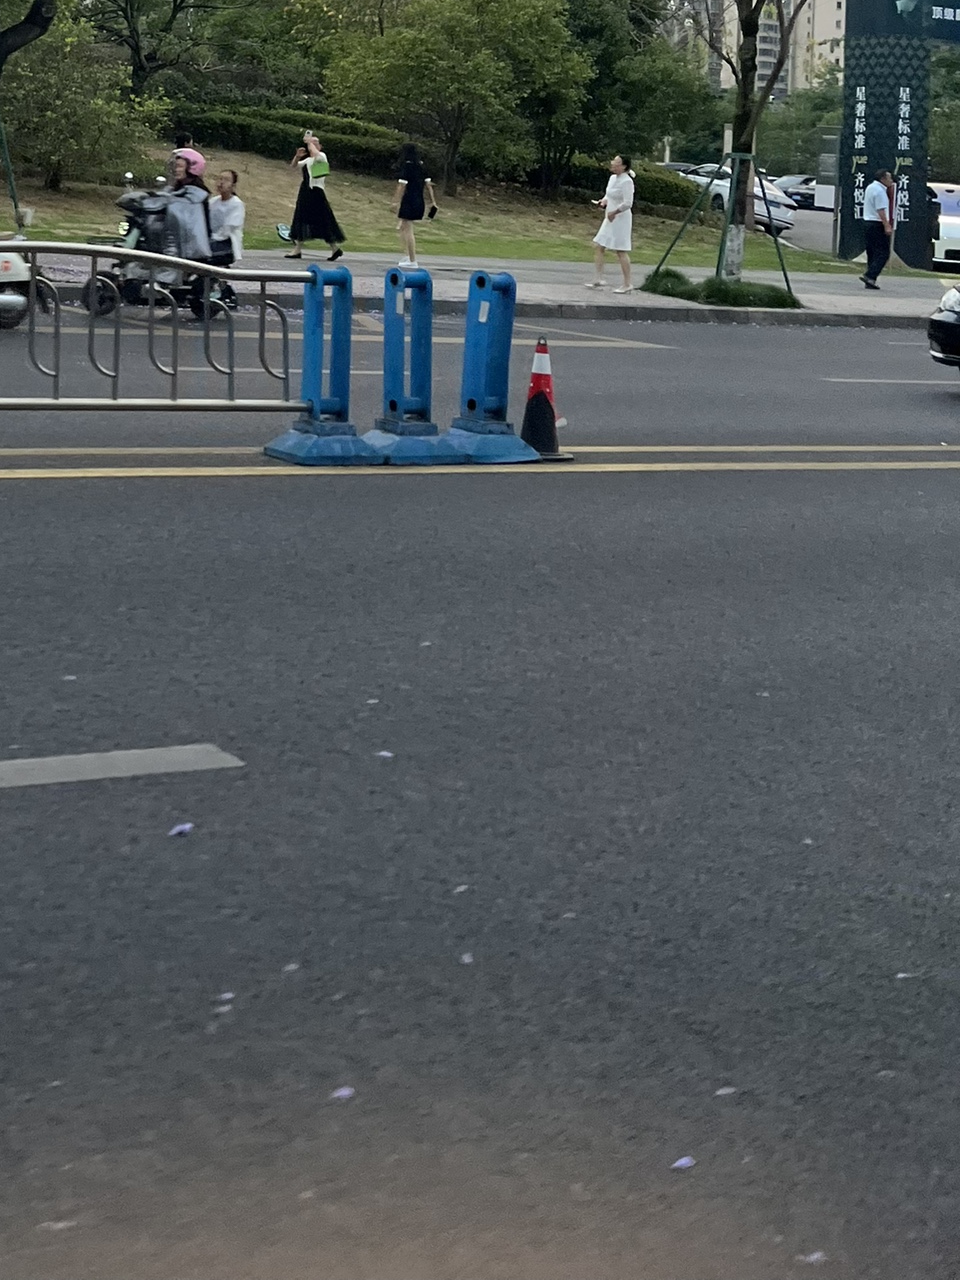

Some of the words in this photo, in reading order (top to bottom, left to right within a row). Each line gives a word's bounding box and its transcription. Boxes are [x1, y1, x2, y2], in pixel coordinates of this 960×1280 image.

[854, 86, 866, 149] 星奢标准
[898, 87, 911, 150] 星奢标准
[851, 155, 868, 174] yue
[894, 157, 913, 175] yue
[854, 172, 865, 219] 齐悦汇
[896, 174, 910, 222] 齐悦汇
